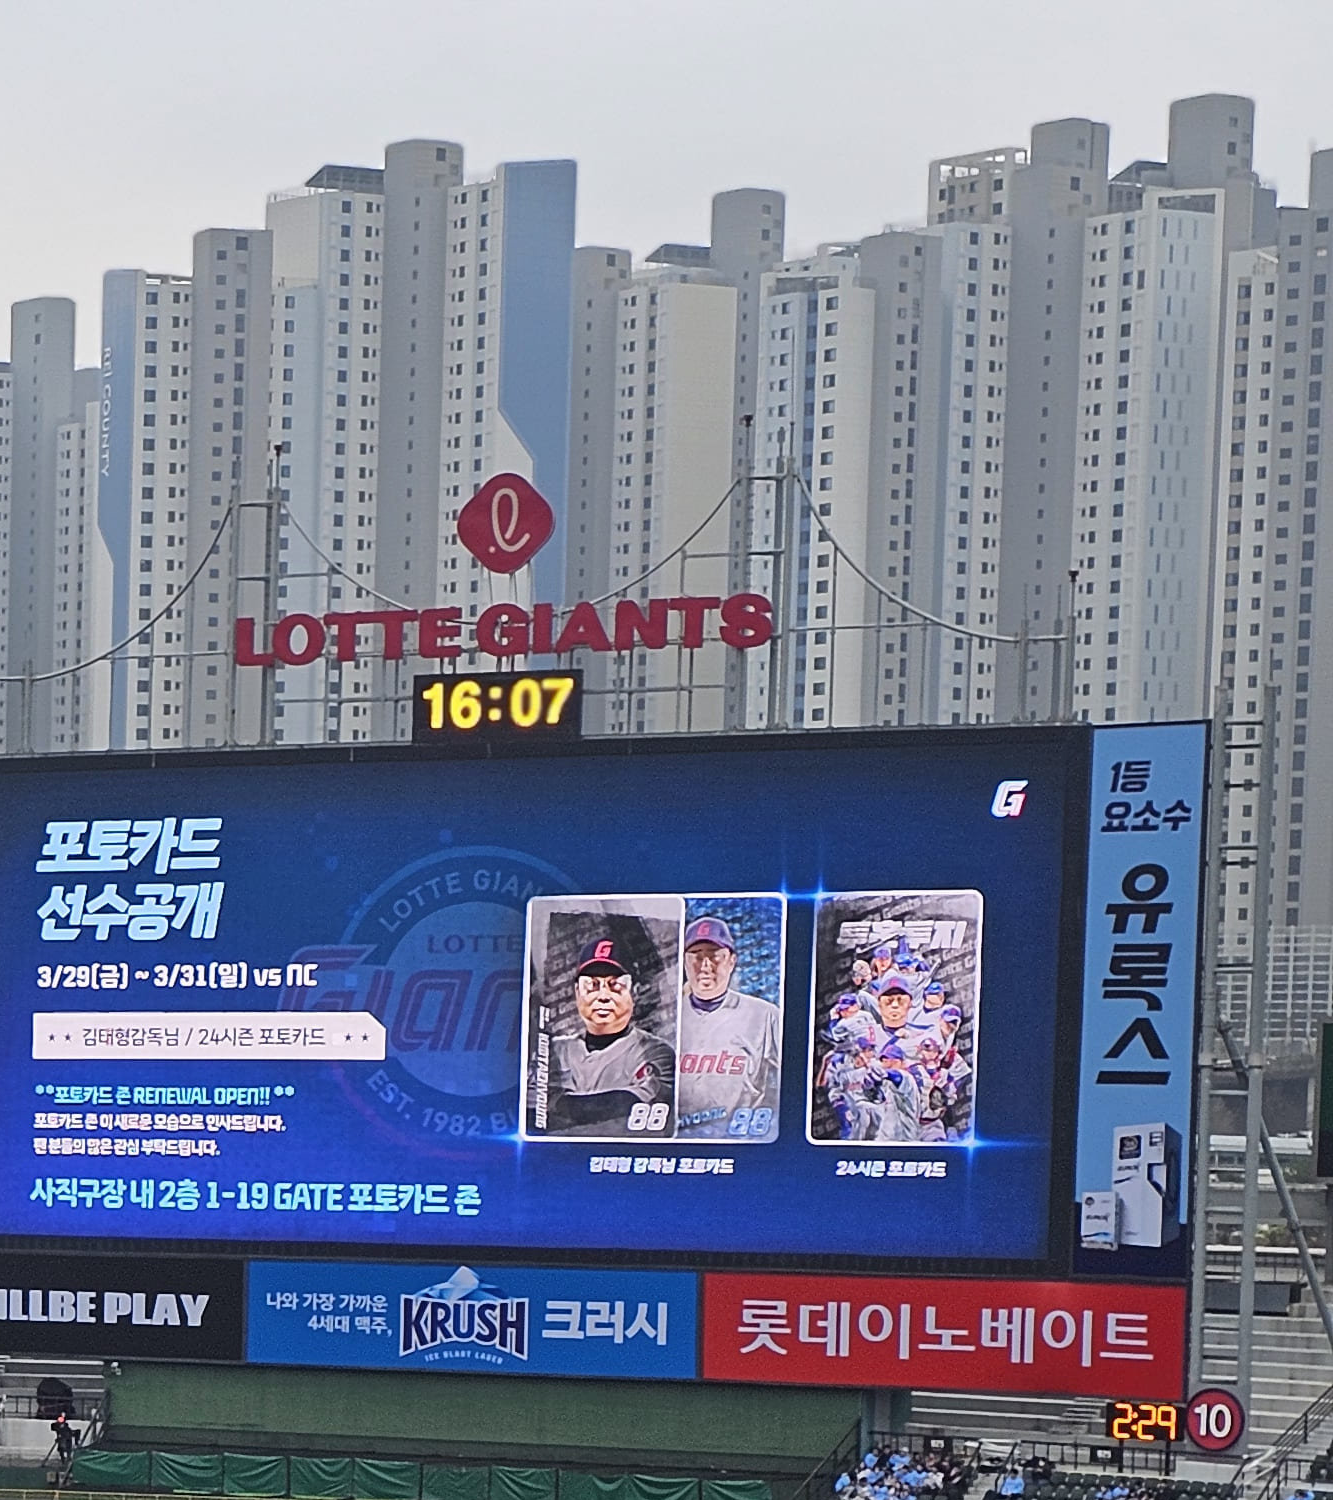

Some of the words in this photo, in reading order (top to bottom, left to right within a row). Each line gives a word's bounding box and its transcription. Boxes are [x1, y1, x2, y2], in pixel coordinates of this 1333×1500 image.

[236, 608, 461, 667] LOTTE
[476, 594, 773, 657] GIANTS
[422, 677, 574, 730] 16:07
[1109, 761, 1152, 793] 1등
[1101, 801, 1192, 833] 요소수
[36, 816, 223, 875] 포토카드
[37, 882, 224, 941] 선수공개
[37, 963, 129, 990] 3/29(금)
[153, 962, 247, 989] 3/31(일)
[253, 967, 282, 986] vs
[286, 963, 318, 987] NC
[1095, 863, 1174, 1085] 유록스
[82, 1028, 179, 1048] 김태형감독님
[199, 1027, 255, 1047] 24시즌
[259, 1027, 326, 1046] 포토카드
[133, 1086, 211, 1105] RENEWAL
[422, 1107, 481, 1137] 1982
[627, 1102, 669, 1131] 88
[29, 1177, 126, 1208] 사직구장
[131, 1179, 153, 1209] 내
[158, 1179, 199, 1210] 2층
[206, 1182, 269, 1210] 1-19
[274, 1182, 341, 1211] GATE
[347, 1184, 450, 1214] 포토카드
[455, 1185, 481, 1216] 존
[112, 1291, 209, 1327] PLAY
[266, 1292, 299, 1310] 나와
[302, 1293, 335, 1312] 가장
[339, 1294, 388, 1313] 가까운
[307, 1315, 350, 1333] 4세대
[355, 1316, 393, 1337] 맥주,
[399, 1294, 529, 1361] KRUSH
[542, 1300, 669, 1346] 크러시
[738, 1300, 1154, 1368] 롯데이노베이트
[1112, 1403, 1178, 1441] 2:29
[1194, 1403, 1232, 1437] 10
